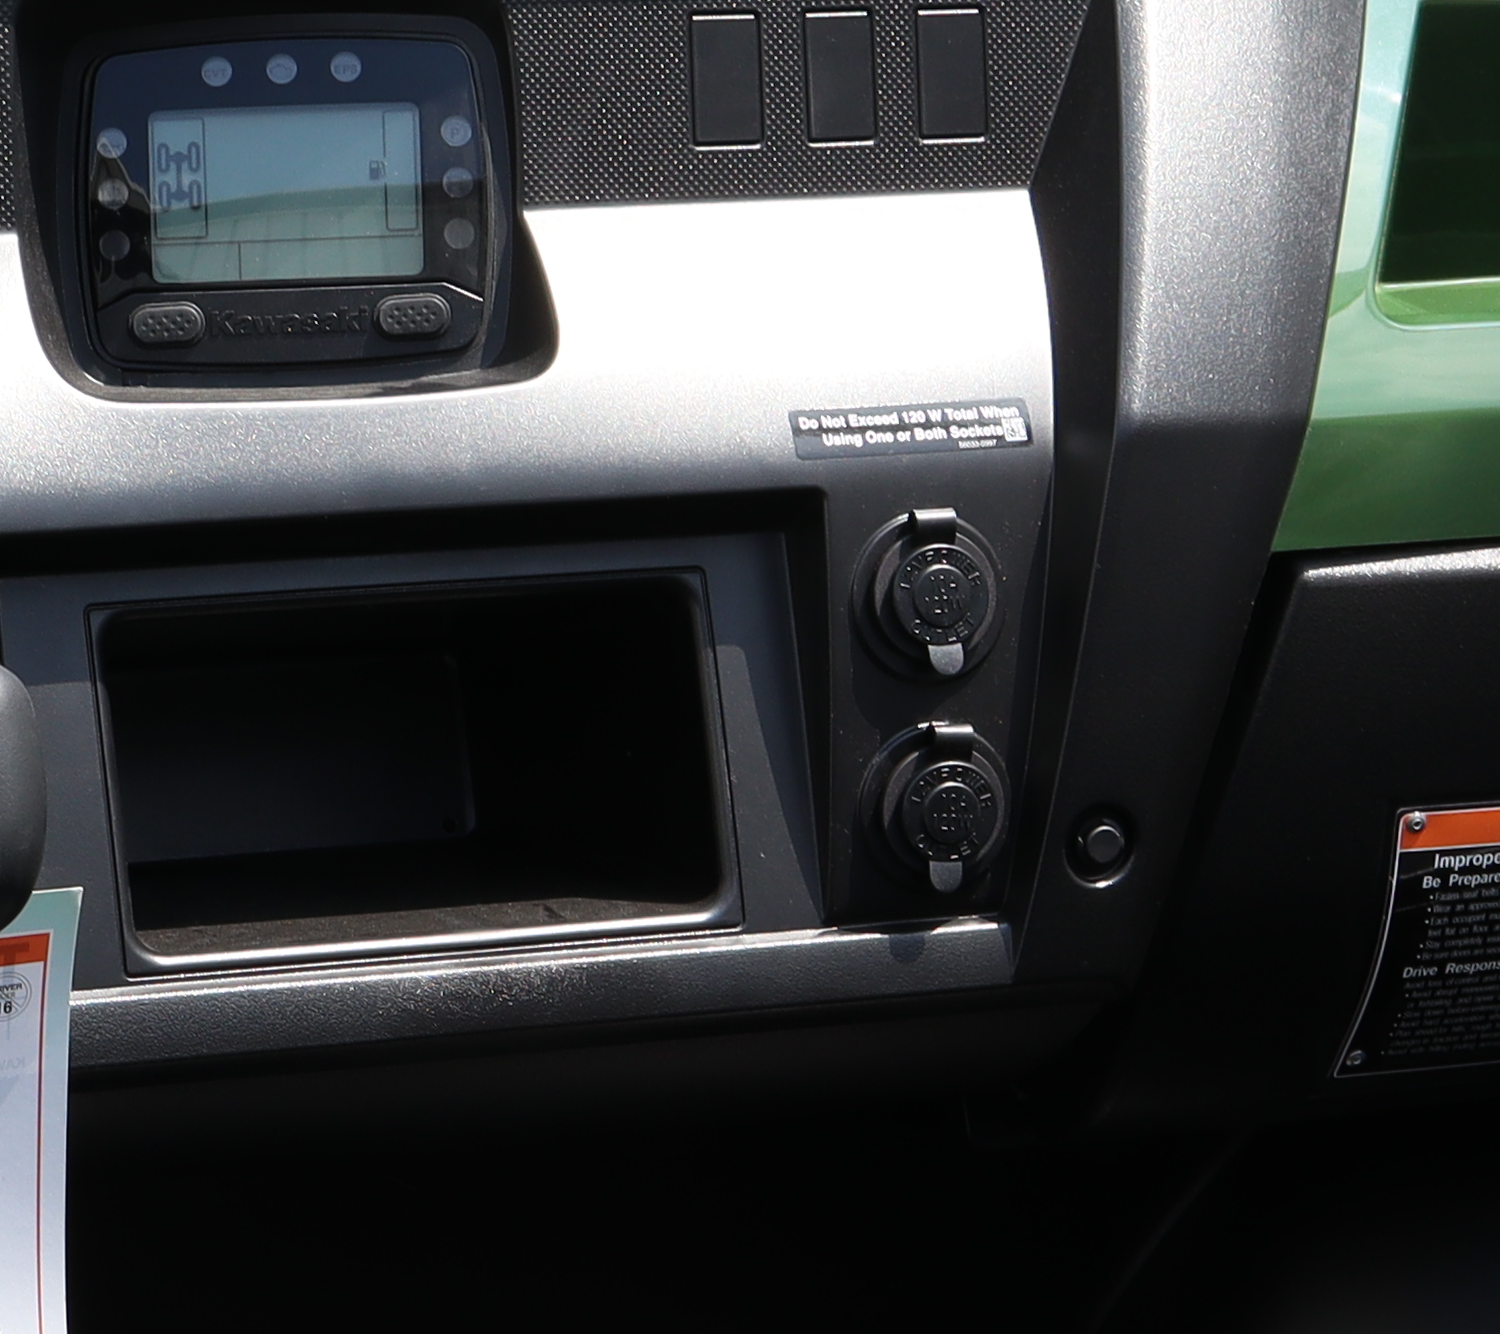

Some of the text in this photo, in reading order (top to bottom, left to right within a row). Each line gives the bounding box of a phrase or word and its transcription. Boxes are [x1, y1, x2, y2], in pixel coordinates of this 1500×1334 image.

[210, 307, 369, 338] Kawasaki
[798, 404, 1018, 429] Do Not Exceed 120 W Total When
[822, 423, 1003, 448] Using One or Both Sockets
[1421, 875, 1442, 890] Be
[1402, 964, 1438, 979] Drive
